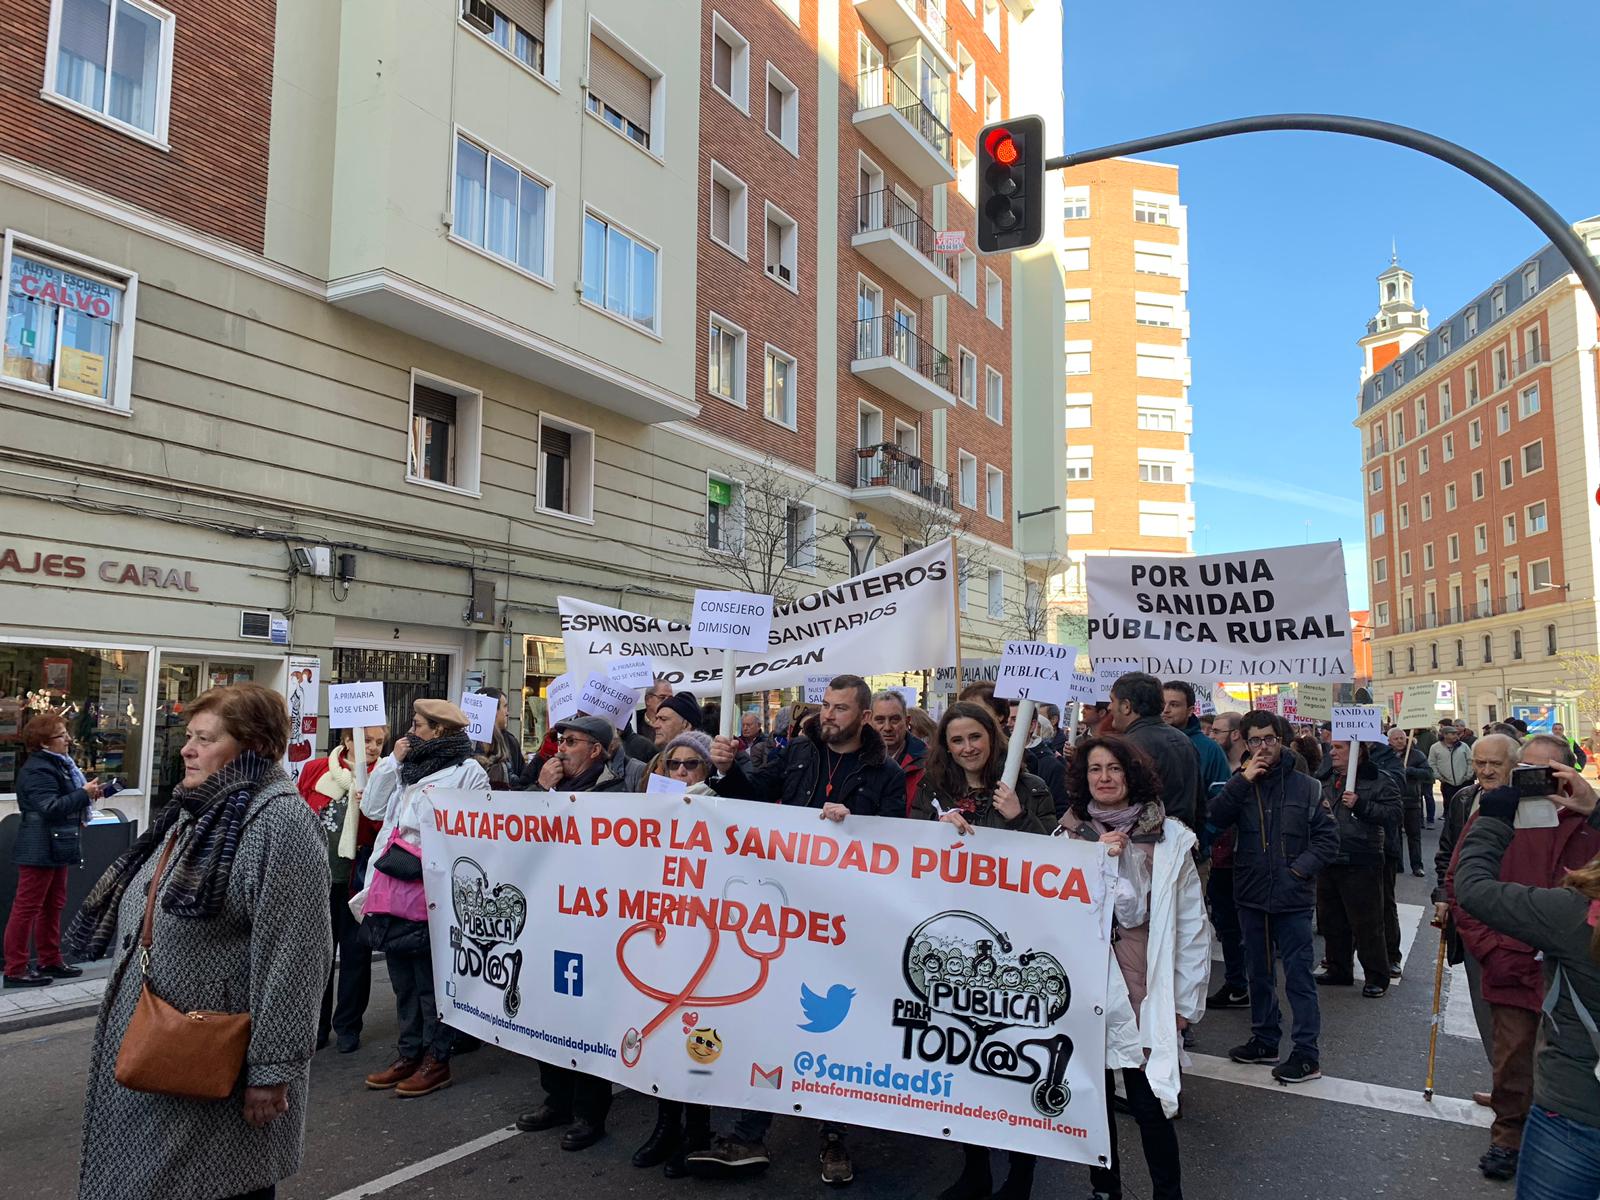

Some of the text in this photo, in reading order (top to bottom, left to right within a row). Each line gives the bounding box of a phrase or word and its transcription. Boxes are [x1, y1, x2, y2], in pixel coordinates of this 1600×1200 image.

[24, 261, 111, 298] AUTO ESCUELA
[21, 275, 111, 317] CALVO
[99, 561, 199, 593] CARAL
[1131, 558, 1275, 588] POR UNA
[560, 614, 660, 634] ESPINOSA
[772, 560, 948, 619] MONTEROS
[700, 600, 766, 618] CONSEJERO
[1136, 589, 1276, 616] SANIDAD
[393, 627, 400, 640] 2
[588, 641, 613, 656] LA
[619, 642, 694, 658] SANIDAD
[768, 601, 898, 646] SANITARIOS
[697, 621, 752, 637] DIMISION
[1087, 613, 1346, 644] PÚBLICA RURAL
[1007, 643, 1067, 660] SANIDAD
[618, 661, 646, 671] PRIMARIA
[630, 670, 649, 680] VENDE
[690, 668, 724, 684] SE
[734, 647, 826, 679] TOCAN
[1003, 665, 1060, 682] PUBLICA
[1201, 657, 1233, 676] DE
[1239, 656, 1347, 677] MONTIJA
[1069, 683, 1094, 695] BLICA
[1071, 673, 1096, 683] NIDAD
[341, 690, 375, 700] PRIMARIA
[581, 692, 622, 716] DIMISION
[589, 679, 634, 706] CONSEJERO
[1017, 687, 1031, 699] SI
[333, 704, 379, 715] NO SE VENDE
[1334, 708, 1375, 717] SANIDAD
[1335, 721, 1375, 729] PUBLICA
[1349, 733, 1358, 741] SI
[434, 807, 1092, 905] PLATAFORMA POR LA SANIDAD PÚBLICA
[661, 854, 708, 890] EN
[558, 883, 848, 946] LAS MERINDADES
[892, 998, 931, 1022] PARA
[793, 1050, 955, 1098] @SanidadSí
[791, 1078, 1088, 1139] plataformasanidmerindades@gmail.com
